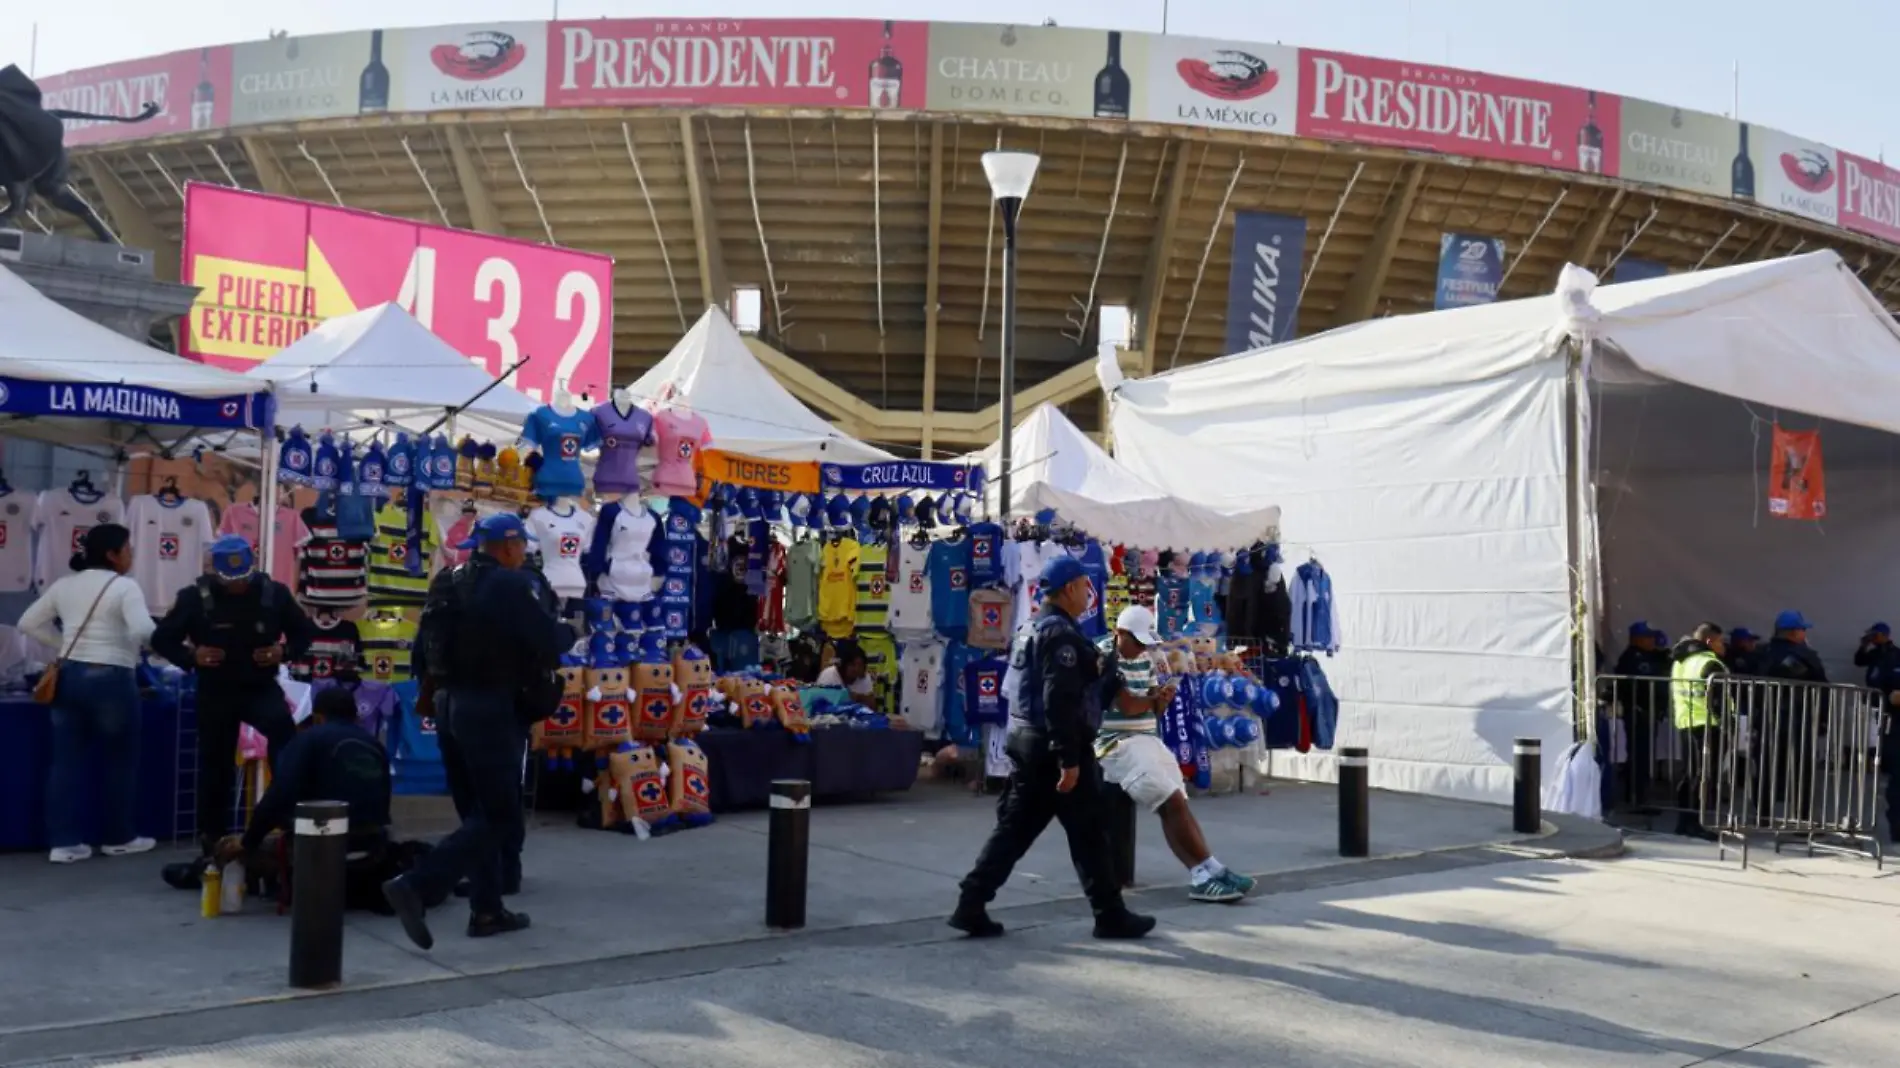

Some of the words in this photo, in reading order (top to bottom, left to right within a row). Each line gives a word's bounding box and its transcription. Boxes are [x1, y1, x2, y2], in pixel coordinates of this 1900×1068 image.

[655, 21, 743, 33] BRANDY
[560, 27, 836, 90] PRESIDENTE
[939, 56, 1073, 84] CHATEAU
[1401, 67, 1479, 86] BRANDY
[430, 90, 452, 105] LA
[455, 87, 524, 104] MÉXICO
[950, 85, 1064, 105] DOMECQ
[1309, 57, 1553, 149] PRESIDENTE
[1177, 104, 1200, 119] LA
[1203, 105, 1278, 127] MÉXICO
[218, 273, 318, 318] PUERTA
[1248, 241, 1282, 350] ALIKA
[201, 308, 321, 347] EXTERIO
[50, 385, 76, 410] LA
[83, 387, 181, 420] MAQUINA
[725, 457, 792, 485] TIGRES
[861, 464, 899, 484] CRUZ
[902, 465, 935, 485] AZUL
